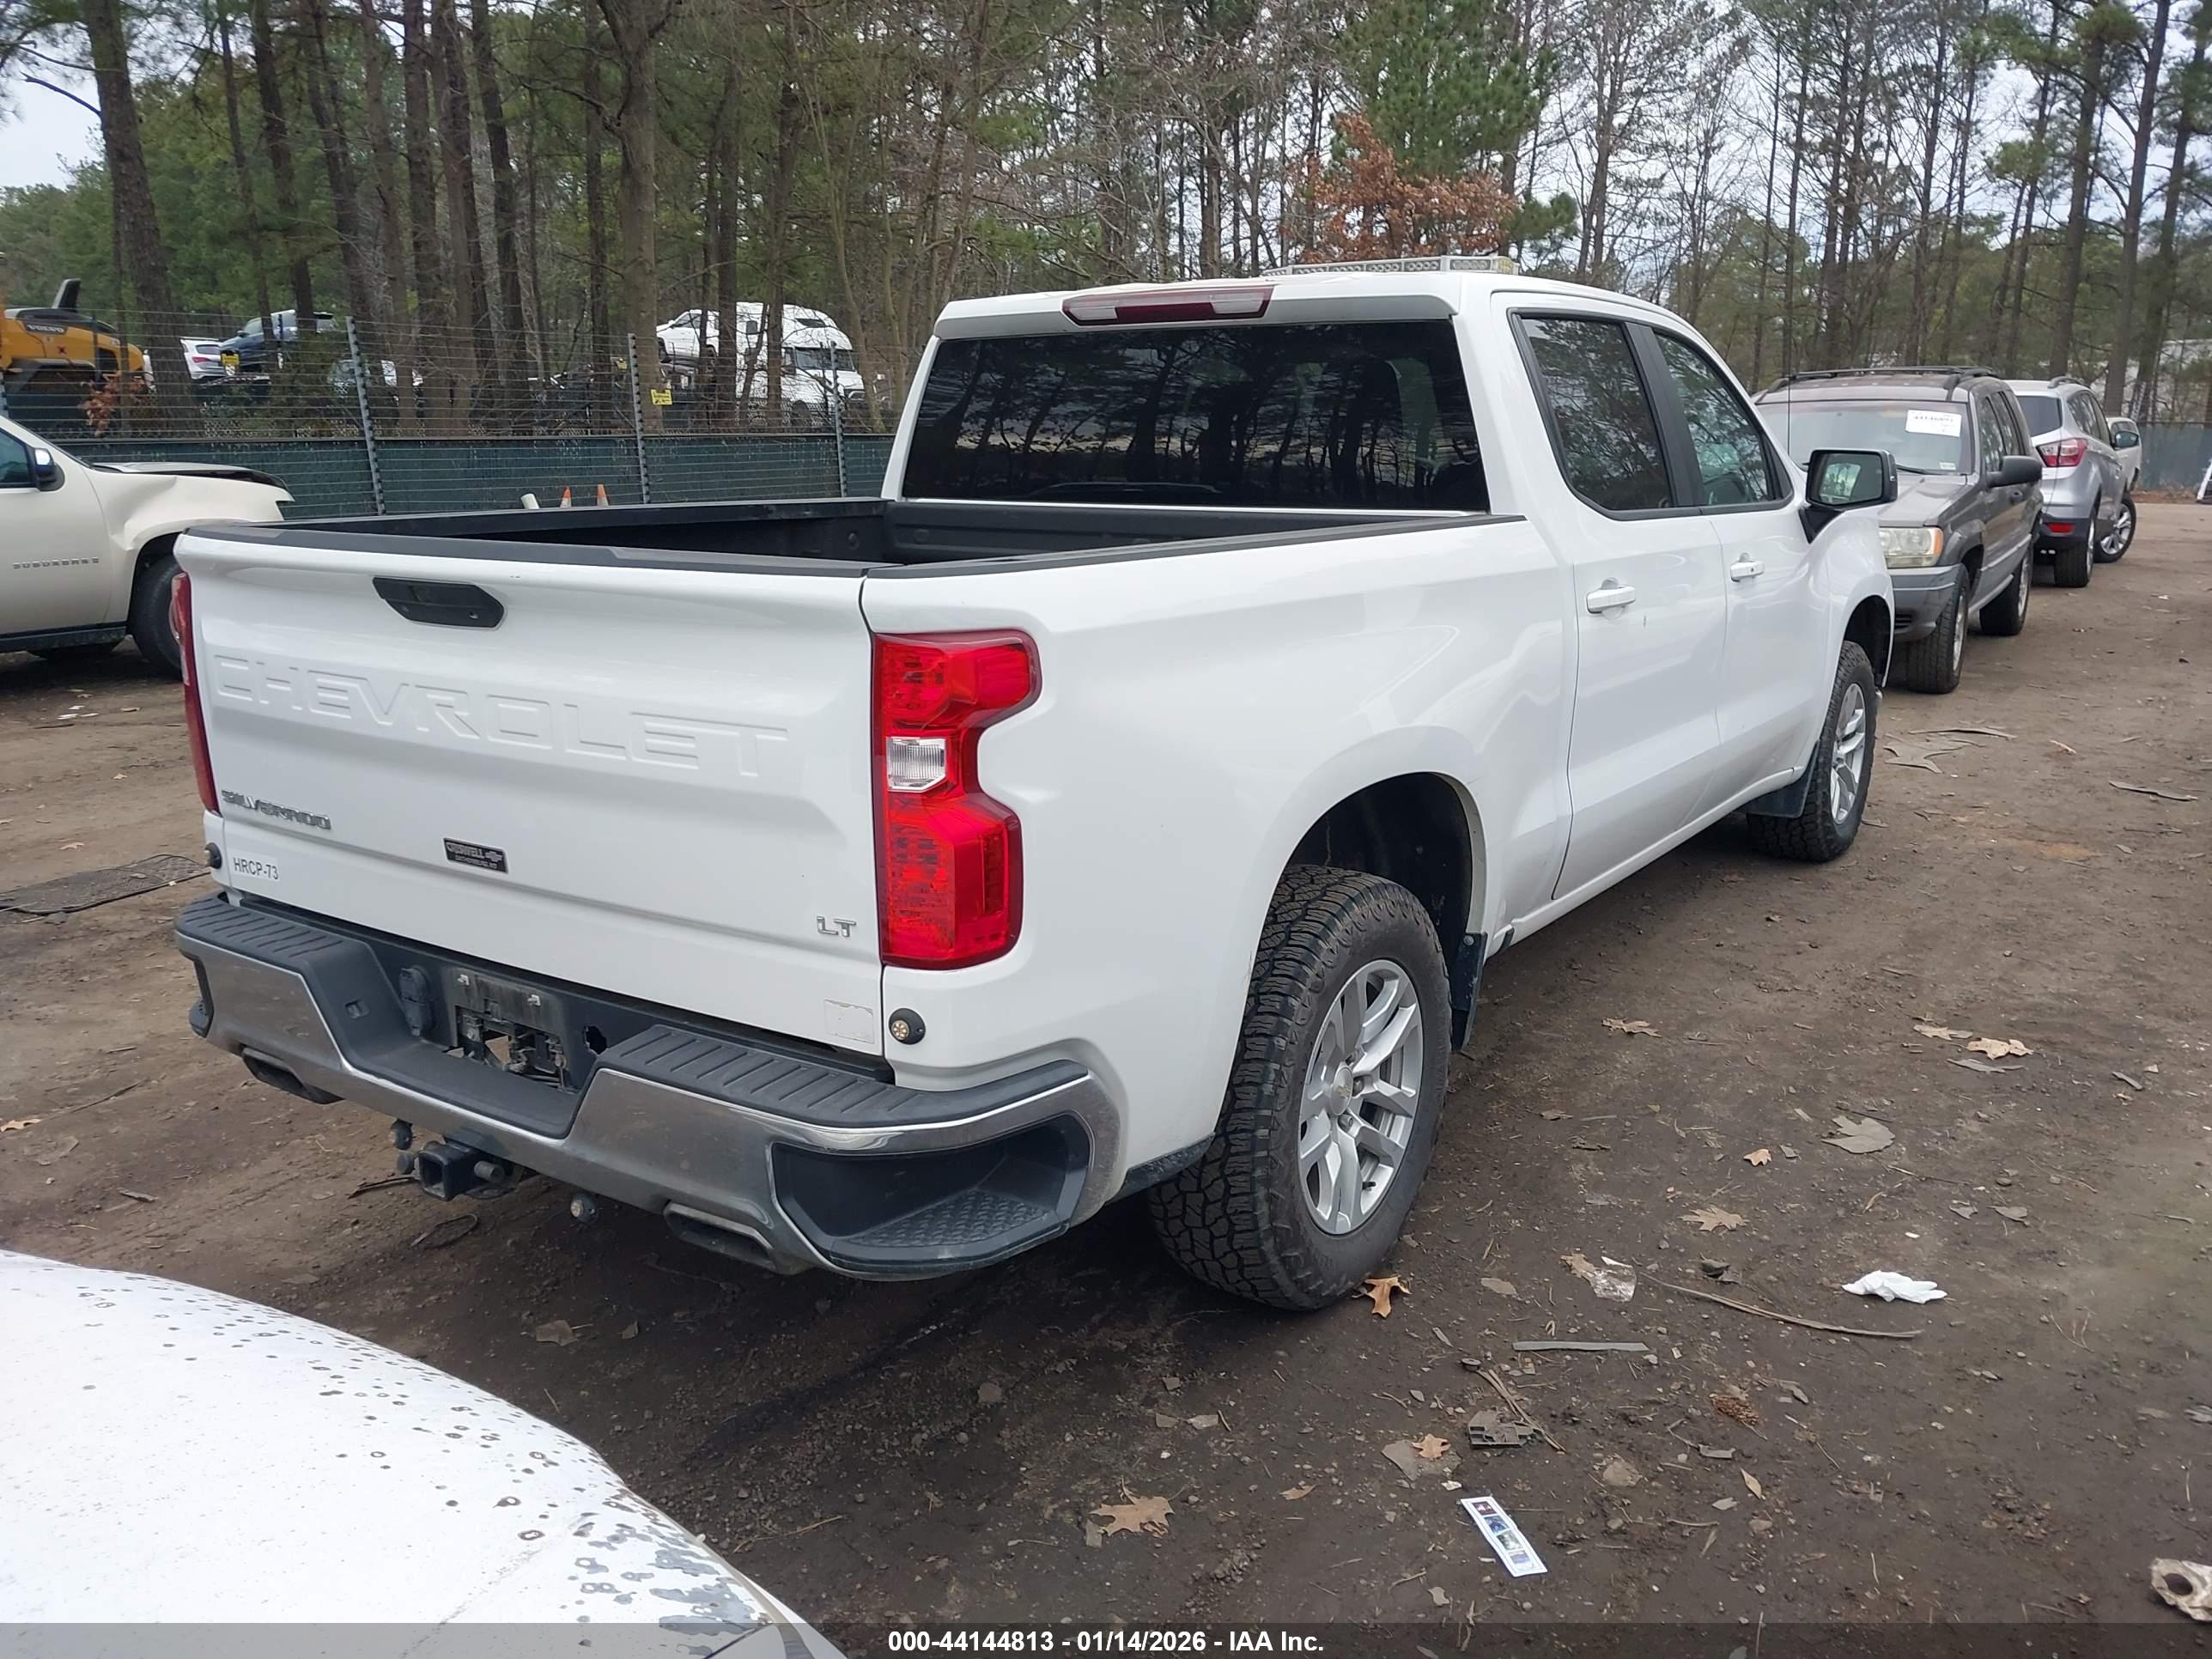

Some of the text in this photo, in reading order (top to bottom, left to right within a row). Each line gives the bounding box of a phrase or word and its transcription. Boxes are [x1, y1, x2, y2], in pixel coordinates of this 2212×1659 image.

[213, 654, 788, 777] CHEVROLET
[221, 789, 331, 830] SILVERADO
[233, 856, 279, 880] HRCP-73
[817, 915, 857, 938] LT
